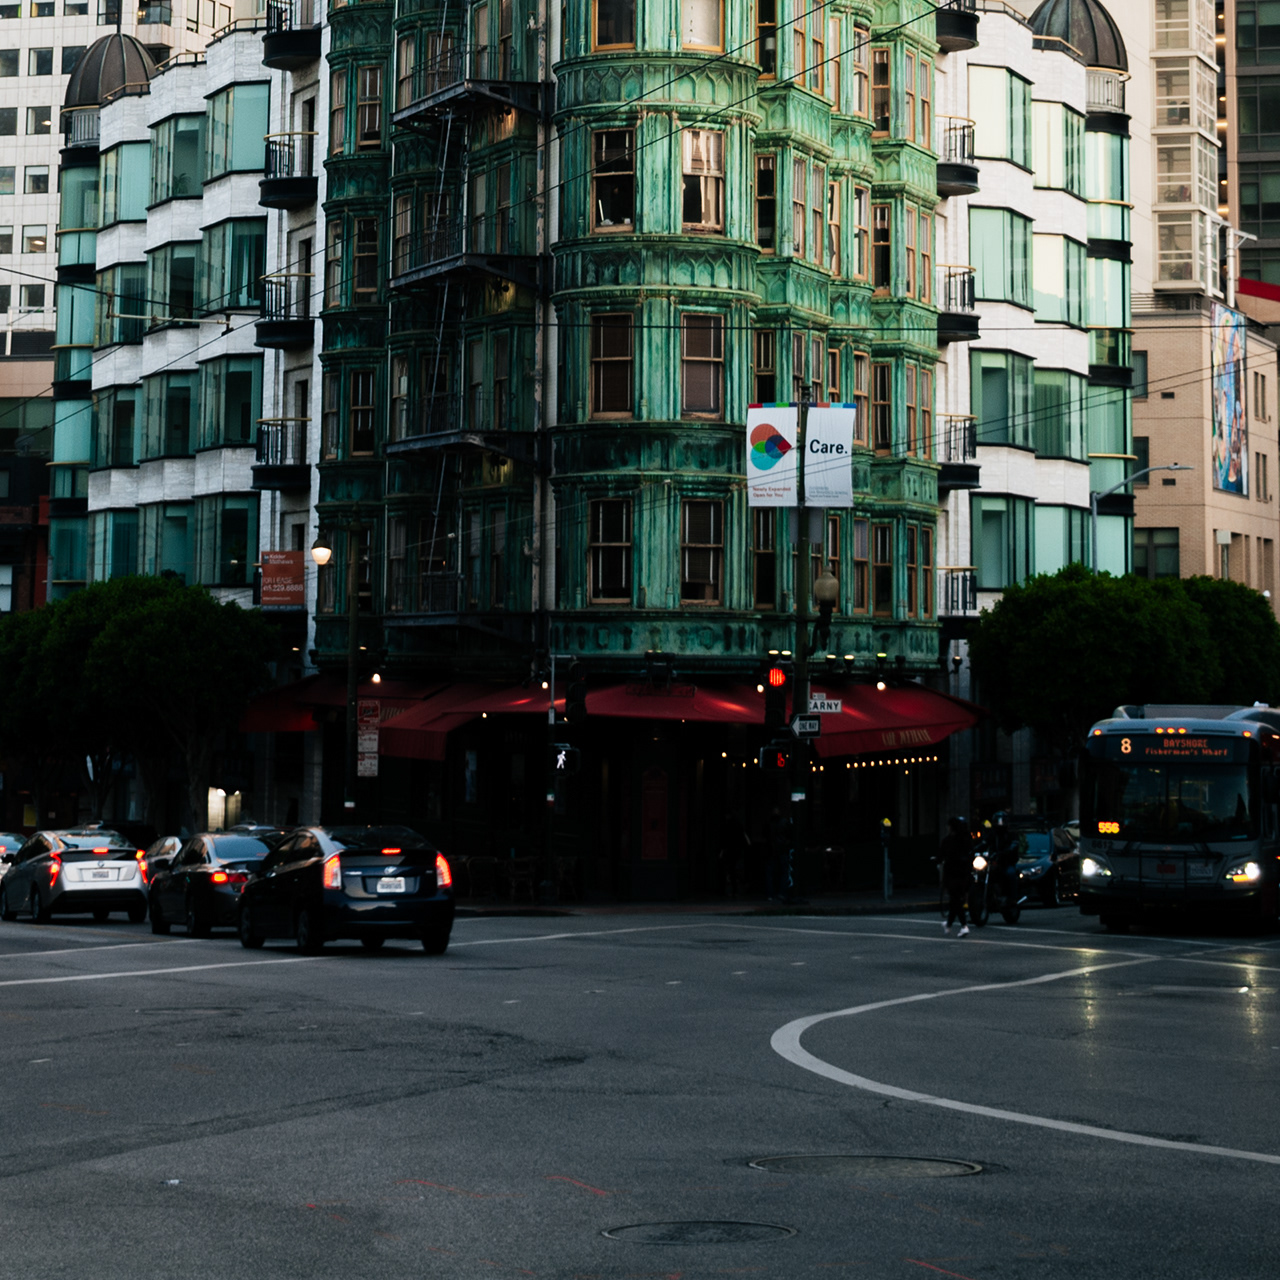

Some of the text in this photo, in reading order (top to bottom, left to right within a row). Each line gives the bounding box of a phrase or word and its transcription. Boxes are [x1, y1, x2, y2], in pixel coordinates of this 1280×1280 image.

[809, 438, 848, 455] Care.
[809, 700, 840, 711] ARNY
[799, 720, 818, 732] ONE WAY
[1120, 737, 1209, 755] 8 BAYSHORE
[1144, 747, 1228, 757] Fisherman's Wharf
